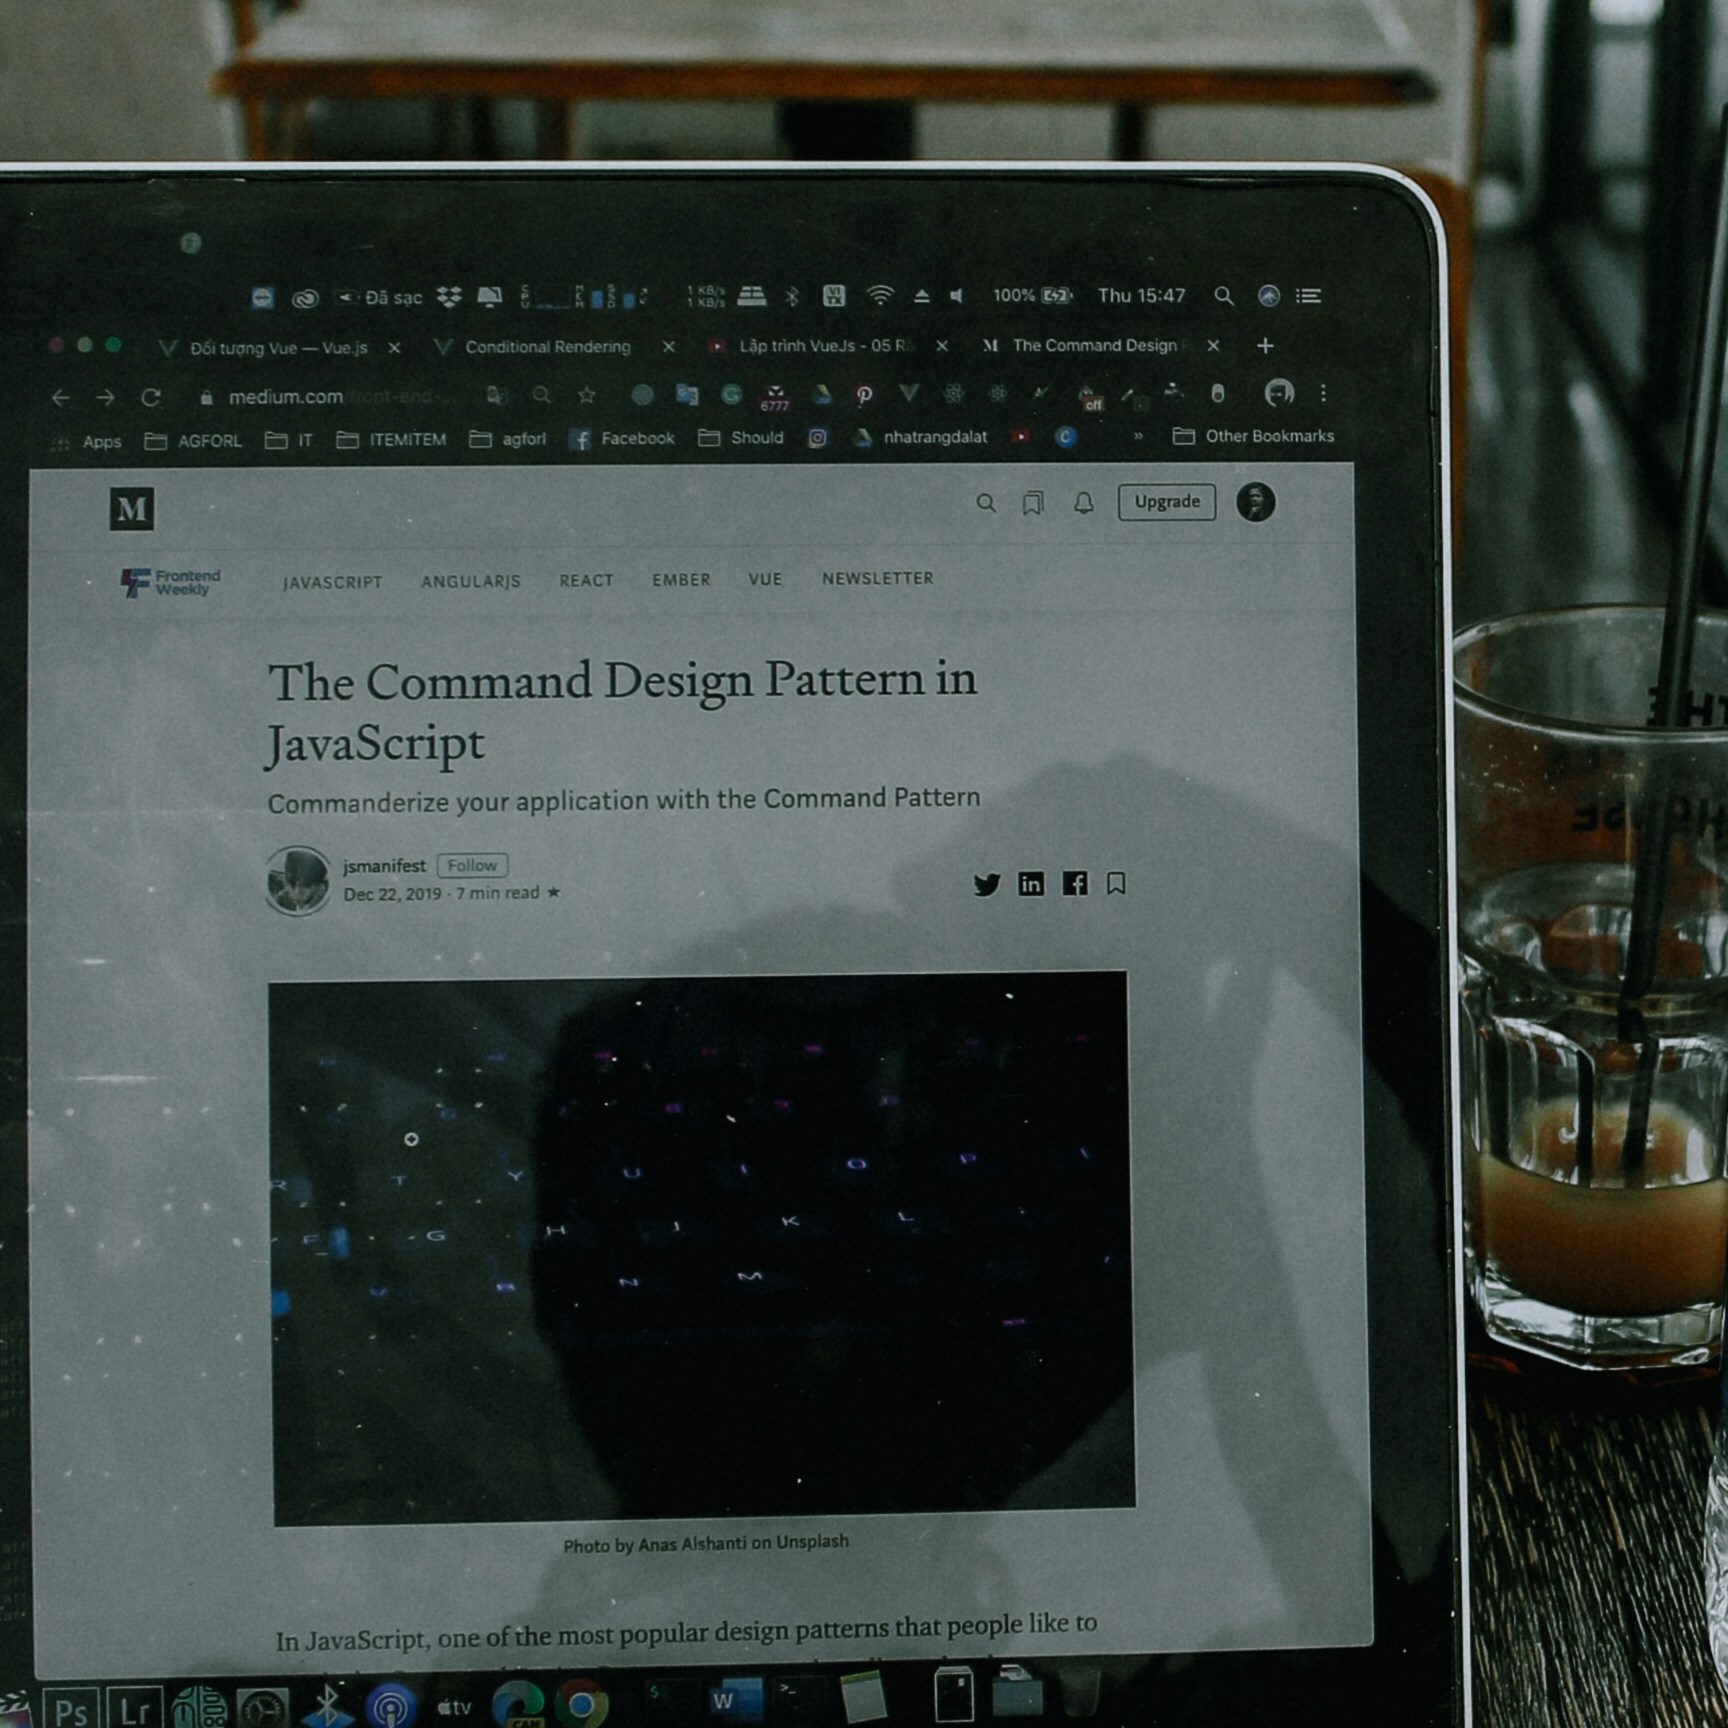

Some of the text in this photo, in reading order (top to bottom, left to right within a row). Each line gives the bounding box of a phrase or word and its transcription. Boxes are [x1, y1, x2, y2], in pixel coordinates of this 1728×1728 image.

[994, 288, 1035, 302] 100%
[1098, 288, 1185, 303] Thu 15:47
[269, 343, 298, 354] Vue
[323, 342, 368, 356] Vue.js
[466, 340, 630, 356] Conditional Rendering
[740, 338, 767, 354] Lập
[871, 339, 891, 352] 05
[1014, 337, 1178, 356] The Command Design
[759, 401, 789, 413] 6777
[1086, 400, 1102, 410] off
[83, 436, 121, 450] Apps
[179, 434, 243, 448] AGFORL
[299, 433, 312, 446] IT
[371, 433, 446, 446] ITEMITEM
[602, 432, 674, 445] Facebook
[732, 431, 783, 444] Should
[885, 430, 987, 446] nhatrangdalat
[1206, 429, 1335, 443] Other Bookmarks
[1136, 494, 1200, 512] Upgrade
[156, 570, 221, 582] Frontend
[422, 574, 520, 590] ANGULARJS
[560, 574, 613, 587] REACT
[653, 573, 709, 586] EMBER
[749, 573, 781, 586] VUE
[823, 572, 933, 585] NEWSLETTER
[156, 584, 210, 597] Weekly
[283, 576, 382, 592] JAVASCRIPT
[269, 659, 977, 711] The Command Design Pattern in
[263, 723, 484, 773] JavaScript
[268, 786, 980, 818] Commanderize your application with the Command Pattern
[343, 858, 426, 878] jsmanifest
[448, 856, 497, 872] Follow
[344, 885, 539, 902] Dec 22, 2019 7 min read
[562, 1533, 849, 1556] Photo by Anas Alshanti on Unsplash
[277, 1612, 1097, 1654] In JavaScript, one of the most popular design patterns that people like to
[713, 1693, 734, 1710] W
[56, 1700, 87, 1727] Ps
[121, 1698, 149, 1725] Lr
